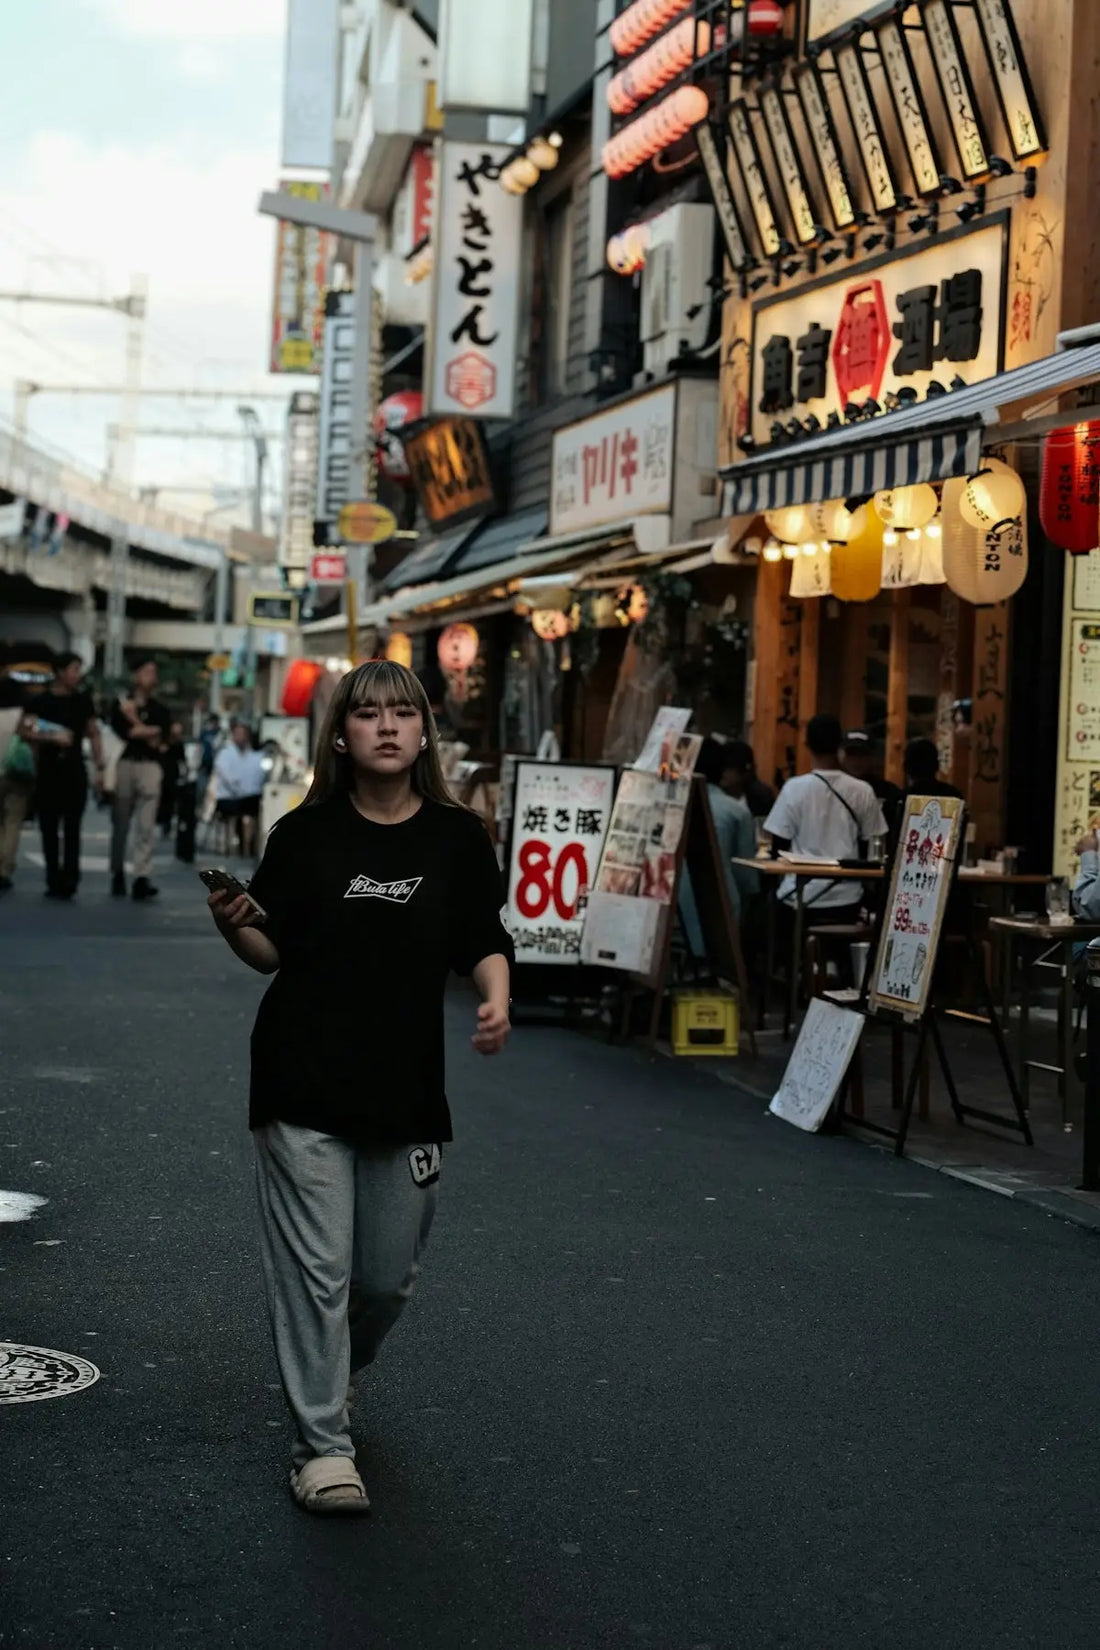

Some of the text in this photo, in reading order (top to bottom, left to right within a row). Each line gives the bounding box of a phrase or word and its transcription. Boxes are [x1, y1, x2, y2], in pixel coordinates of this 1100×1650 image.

[450, 154, 499, 346] やきとん
[522, 804, 603, 836] 焼き豚
